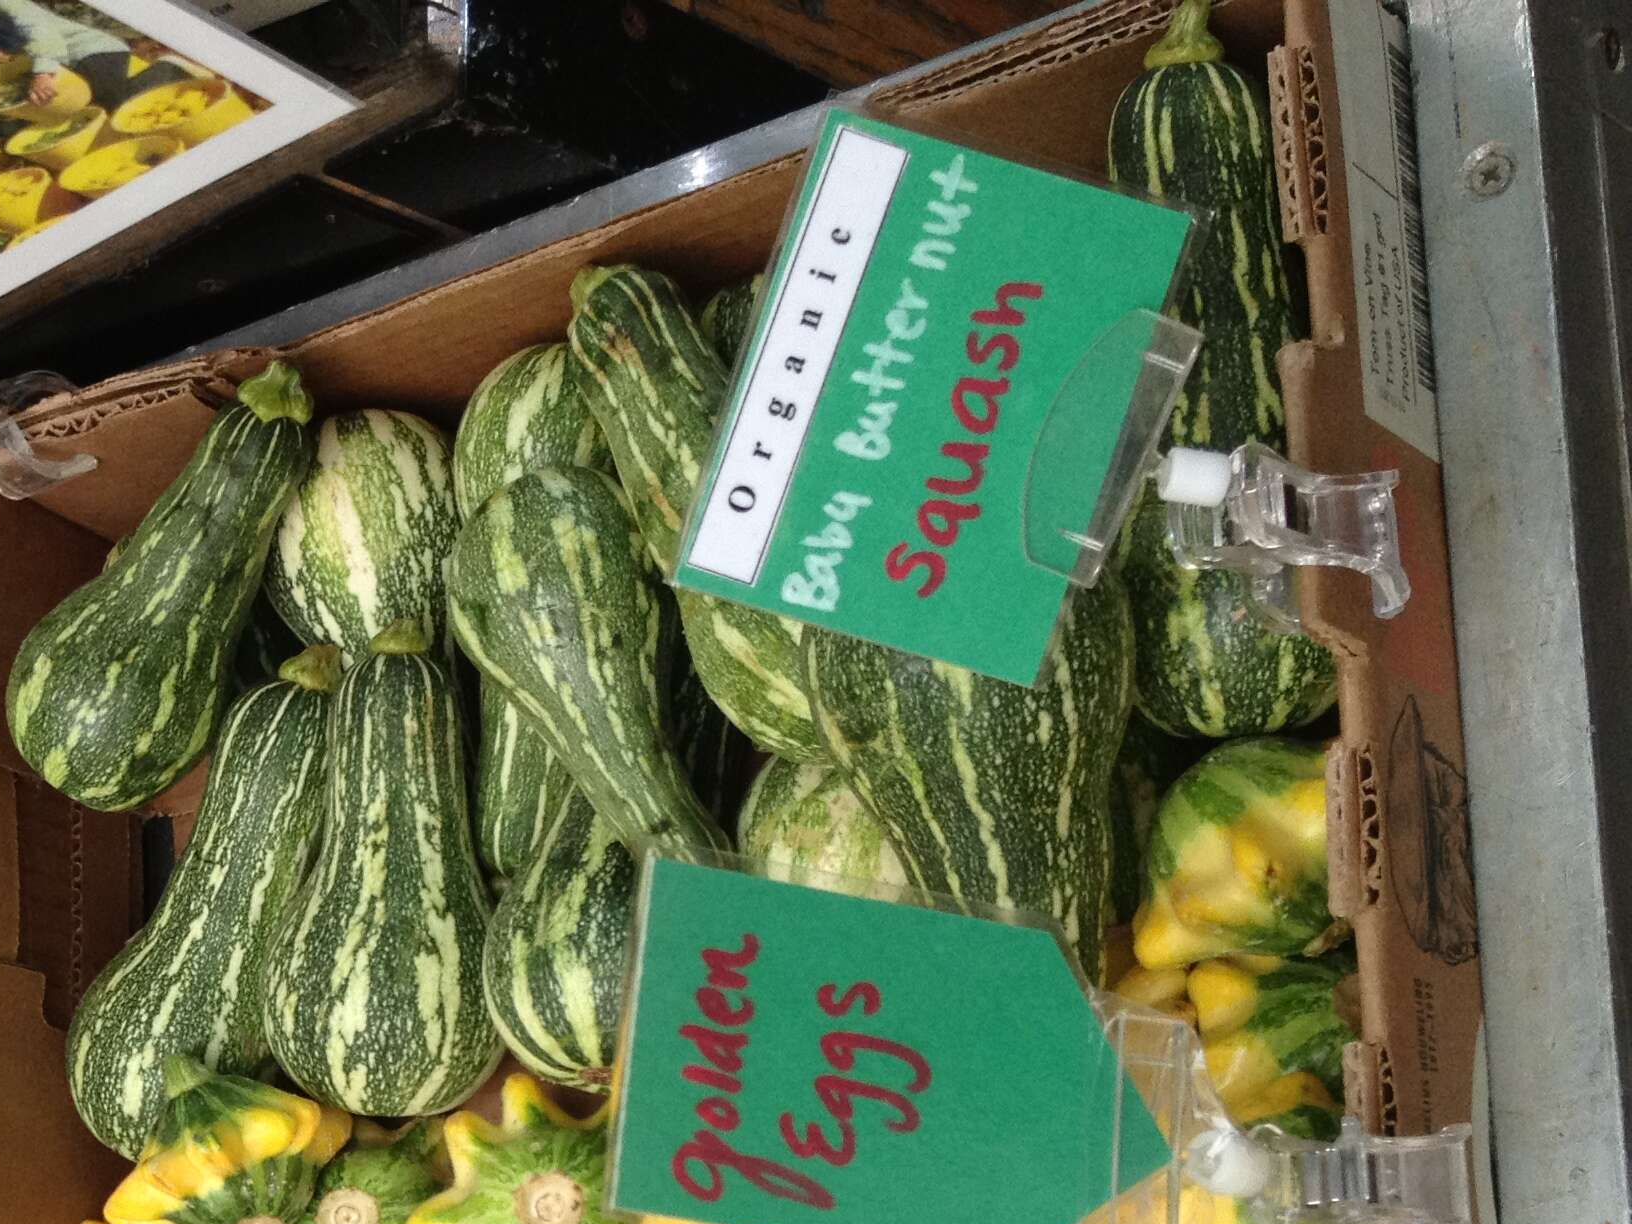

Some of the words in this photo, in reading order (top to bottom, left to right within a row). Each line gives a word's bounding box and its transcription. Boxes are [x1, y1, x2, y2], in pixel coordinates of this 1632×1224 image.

[1380, 281, 1391, 316] Tag
[1391, 247, 1402, 291] USA
[1395, 292, 1403, 316] of
[727, 224, 853, 514] Organic
[1397, 320, 1411, 402] Product
[781, 489, 874, 612] Baby
[778, 980, 932, 1167] Eggs
